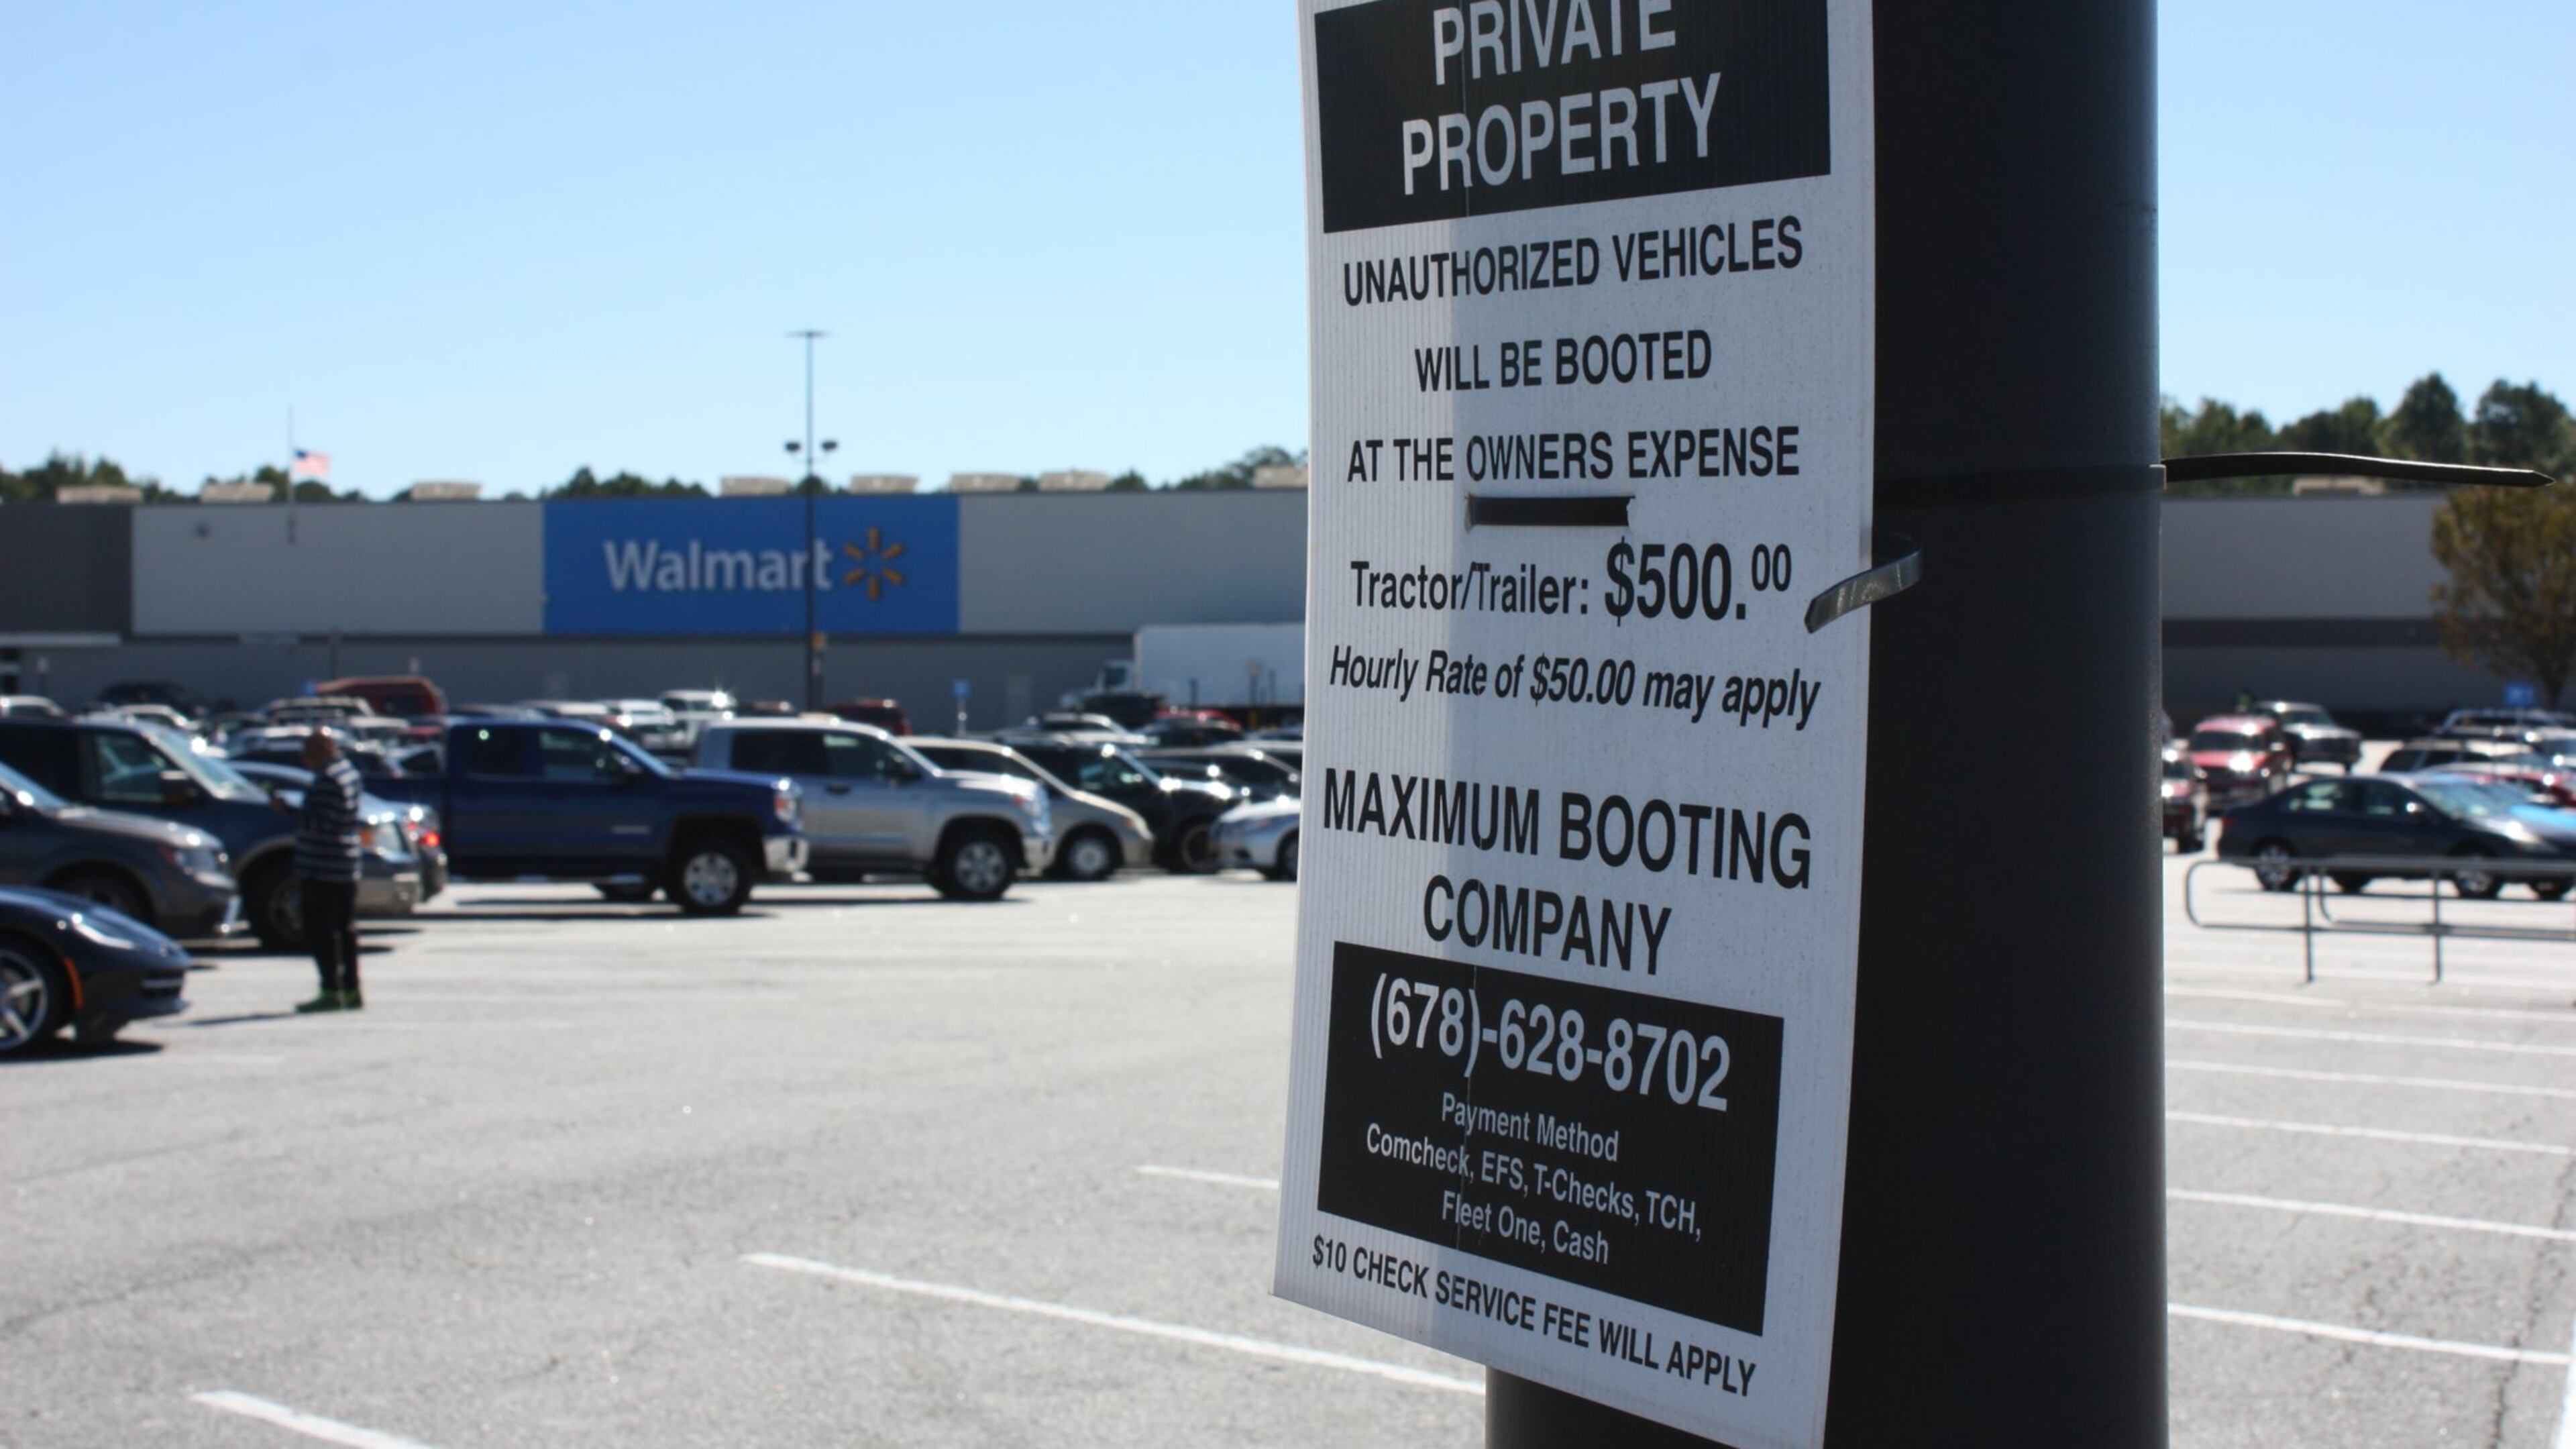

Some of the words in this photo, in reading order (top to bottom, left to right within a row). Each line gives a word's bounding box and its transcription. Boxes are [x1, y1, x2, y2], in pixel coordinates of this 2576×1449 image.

[1434, 0, 1675, 85] PRIVATE
[1403, 73, 1720, 195] PROPERTY
[1345, 238, 1599, 305] UNAUTHORIZED
[1613, 216, 1802, 281] VEHICLES
[1415, 345, 1489, 391] WILL
[1501, 340, 1542, 387] BE
[1556, 330, 1711, 384] BOOTED
[1348, 440, 1383, 482] AT
[1393, 438, 1454, 480] THE
[1467, 432, 1613, 481] OWNERS
[1629, 426, 1799, 478] EXPENSE
[602, 539, 834, 592] Walmart
[1351, 561, 1588, 614] Tractor/Trailer:
[1330, 645, 1419, 702] Hourly
[1426, 651, 1487, 696] Rate
[1495, 655, 1525, 698] of
[1531, 654, 1635, 705] $50.00
[1644, 672, 1715, 723] may
[1722, 669, 1821, 731] apply
[1325, 769, 1539, 855] MAXIMUM
[1560, 792, 1810, 889] BOOTING
[1424, 875, 1672, 975] COMPANY
[1371, 973, 1731, 1112] (678)-628-8702
[1442, 1092, 1529, 1141] Payment
[1538, 1114, 1618, 1161] Method
[1366, 1122, 1474, 1183] Comcheck,
[1482, 1151, 1527, 1196] EFS,
[1534, 1164, 1639, 1225] T-Checks,
[1646, 1191, 1700, 1241] TCH,
[1443, 1191, 1491, 1232] Fleet
[1499, 1206, 1545, 1252] One,
[1554, 1220, 1608, 1264] Cash
[1313, 1235, 1346, 1272] $10
[1353, 1252, 1429, 1298] CHECK
[1436, 1271, 1536, 1331] SERVICE
[1544, 1303, 1590, 1348] FEE
[1600, 1319, 1658, 1369] WILL
[1666, 1342, 1756, 1396] APPLY
